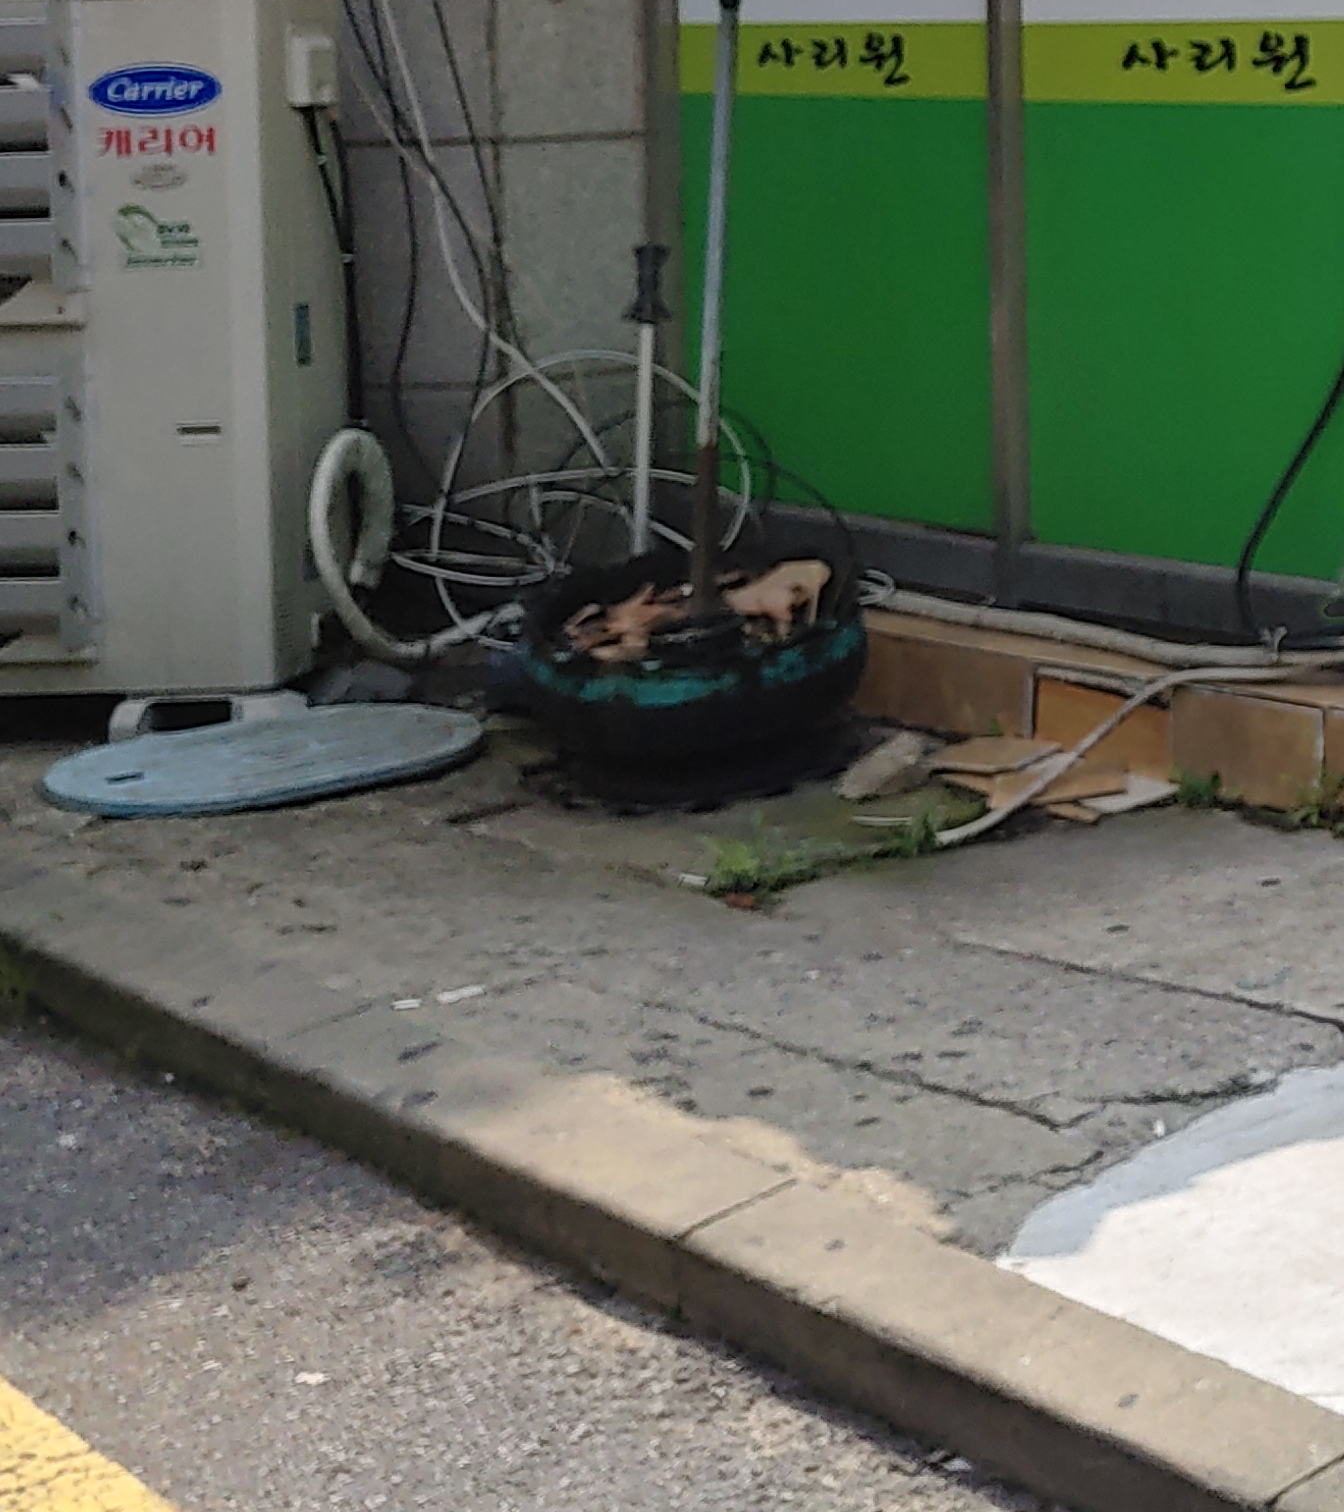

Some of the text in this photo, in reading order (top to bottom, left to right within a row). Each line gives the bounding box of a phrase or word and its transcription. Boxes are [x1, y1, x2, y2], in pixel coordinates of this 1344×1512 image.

[757, 32, 911, 88] 사리원
[1121, 30, 1318, 91] 사리원
[106, 75, 205, 103] Carrier
[98, 125, 217, 158] 캐리어
